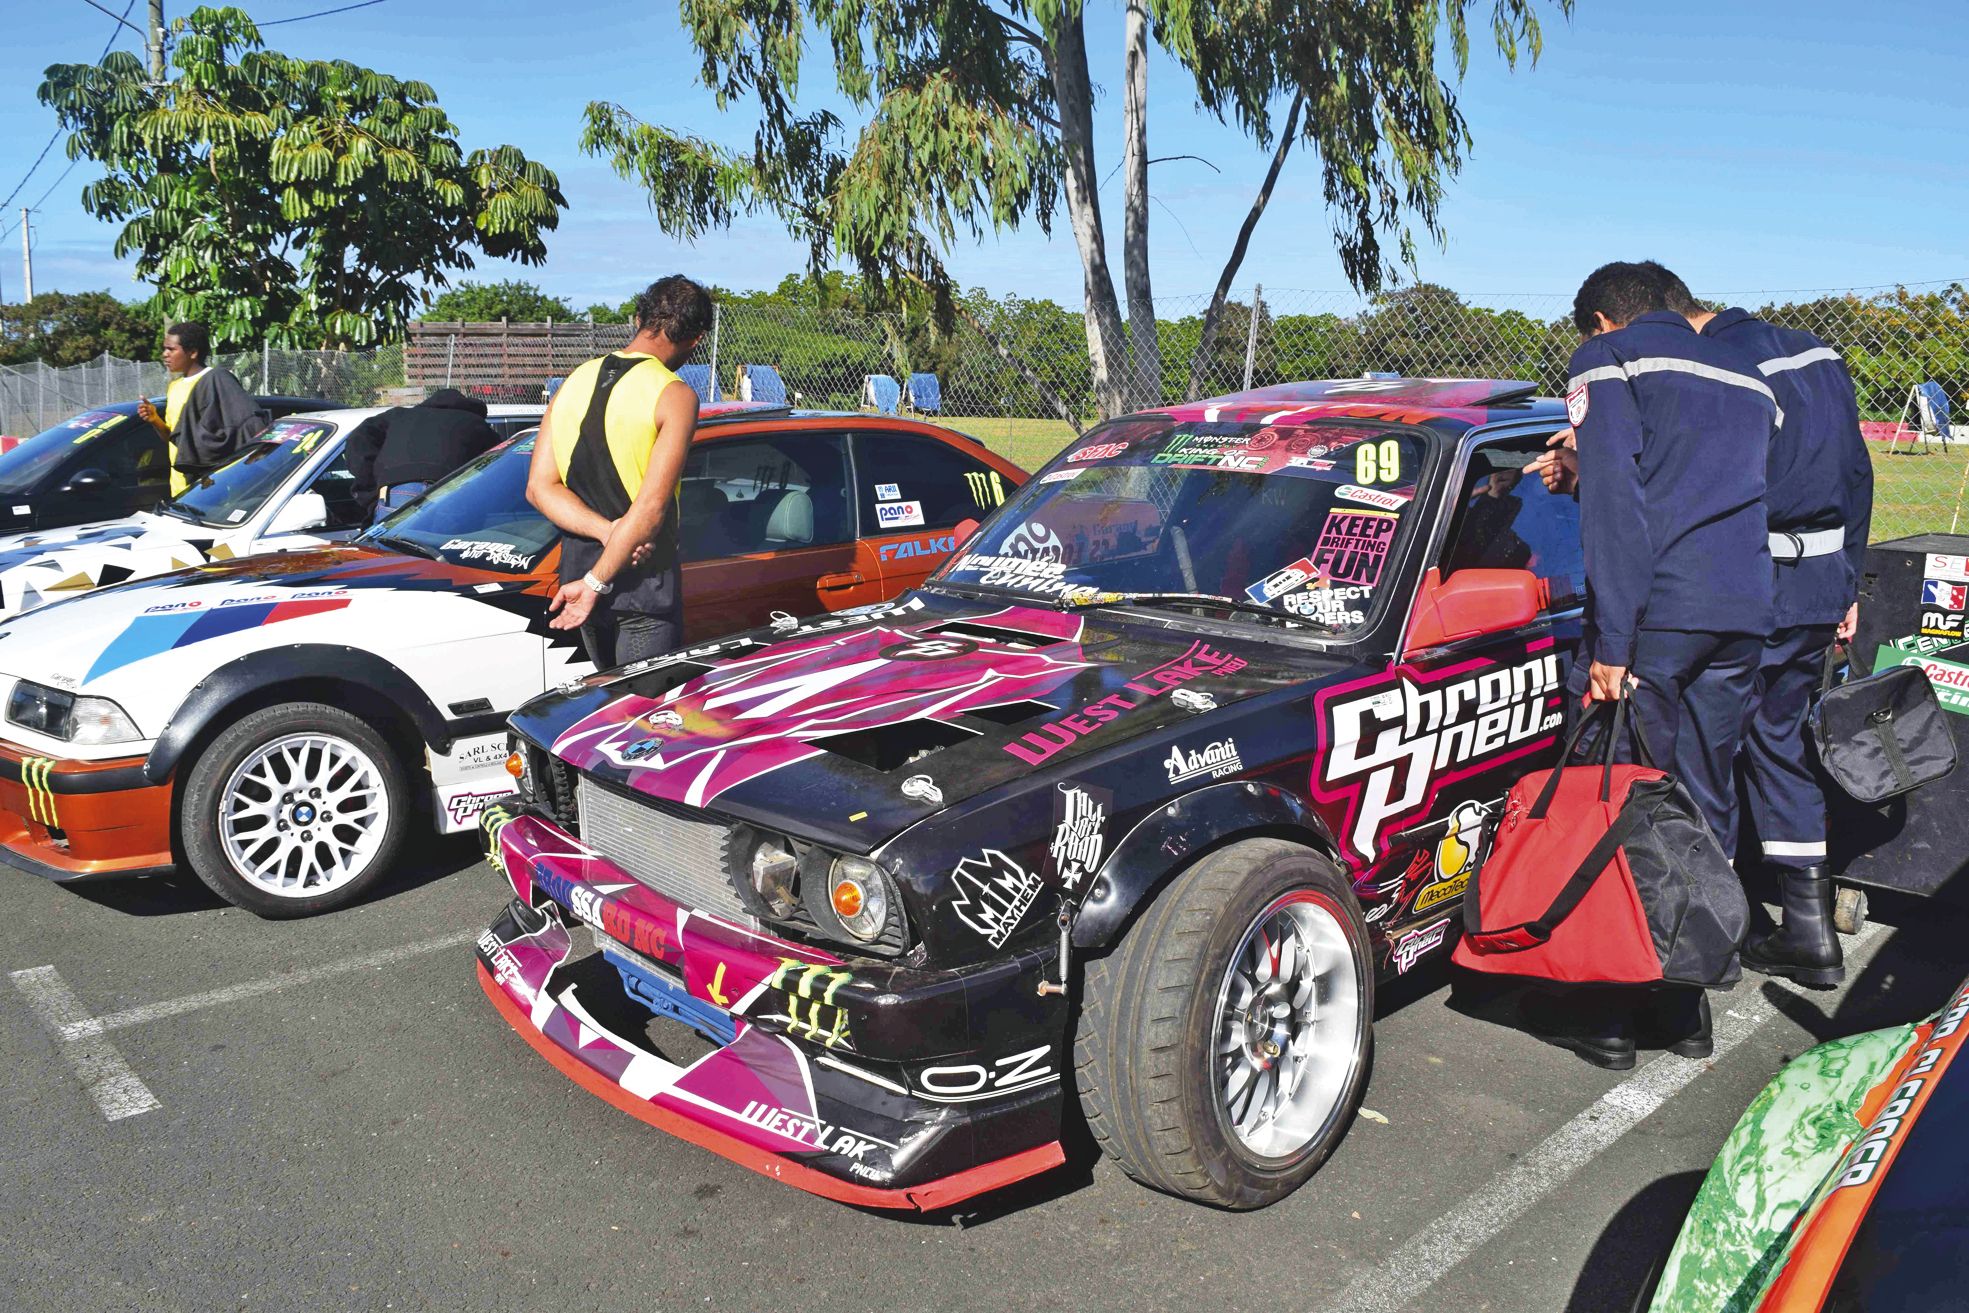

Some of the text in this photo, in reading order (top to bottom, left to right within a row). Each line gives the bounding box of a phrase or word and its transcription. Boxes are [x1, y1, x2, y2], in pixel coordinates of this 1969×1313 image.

[1178, 447, 1249, 457] KING OF
[1356, 439, 1400, 485] 69
[1350, 487, 1400, 508] Castrol
[879, 504, 914, 522] pano
[1324, 514, 1394, 540] KEEP
[1319, 536, 1387, 553] DRIFTING
[1313, 548, 1382, 585] FUN
[1283, 585, 1373, 607] RESPECT
[1003, 639, 1249, 767] WEST LAKE PNEU
[459, 744, 489, 761] SARL
[1163, 737, 1239, 780] Advanti
[1211, 761, 1244, 780] RACING
[988, 871, 1044, 949] MAYHEM
[633, 916, 667, 960] NC
[740, 1100, 816, 1145] WEST
